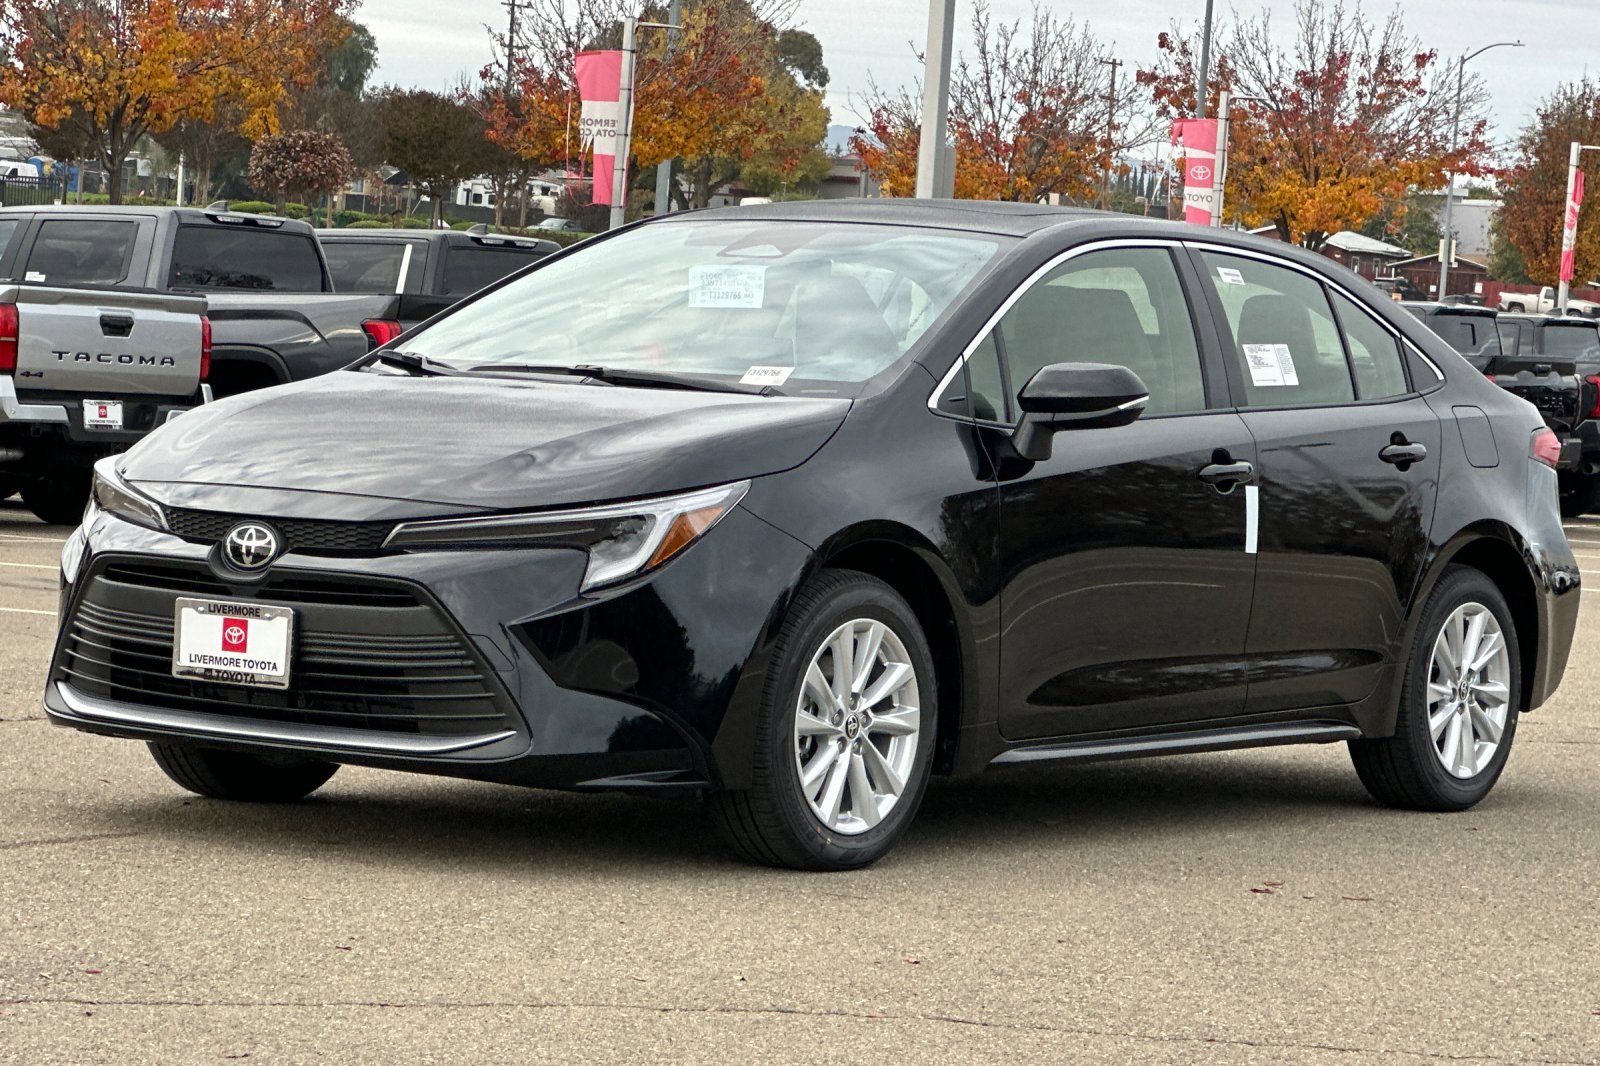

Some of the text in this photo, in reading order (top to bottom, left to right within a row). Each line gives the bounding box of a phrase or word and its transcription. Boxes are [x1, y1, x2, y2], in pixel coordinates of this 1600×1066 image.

[52, 351, 176, 367] TACOMA
[208, 603, 260, 617] LIVERMORE
[189, 653, 278, 671] LIVERMORE TOYOTA
[214, 669, 257, 685] TOYOTA
